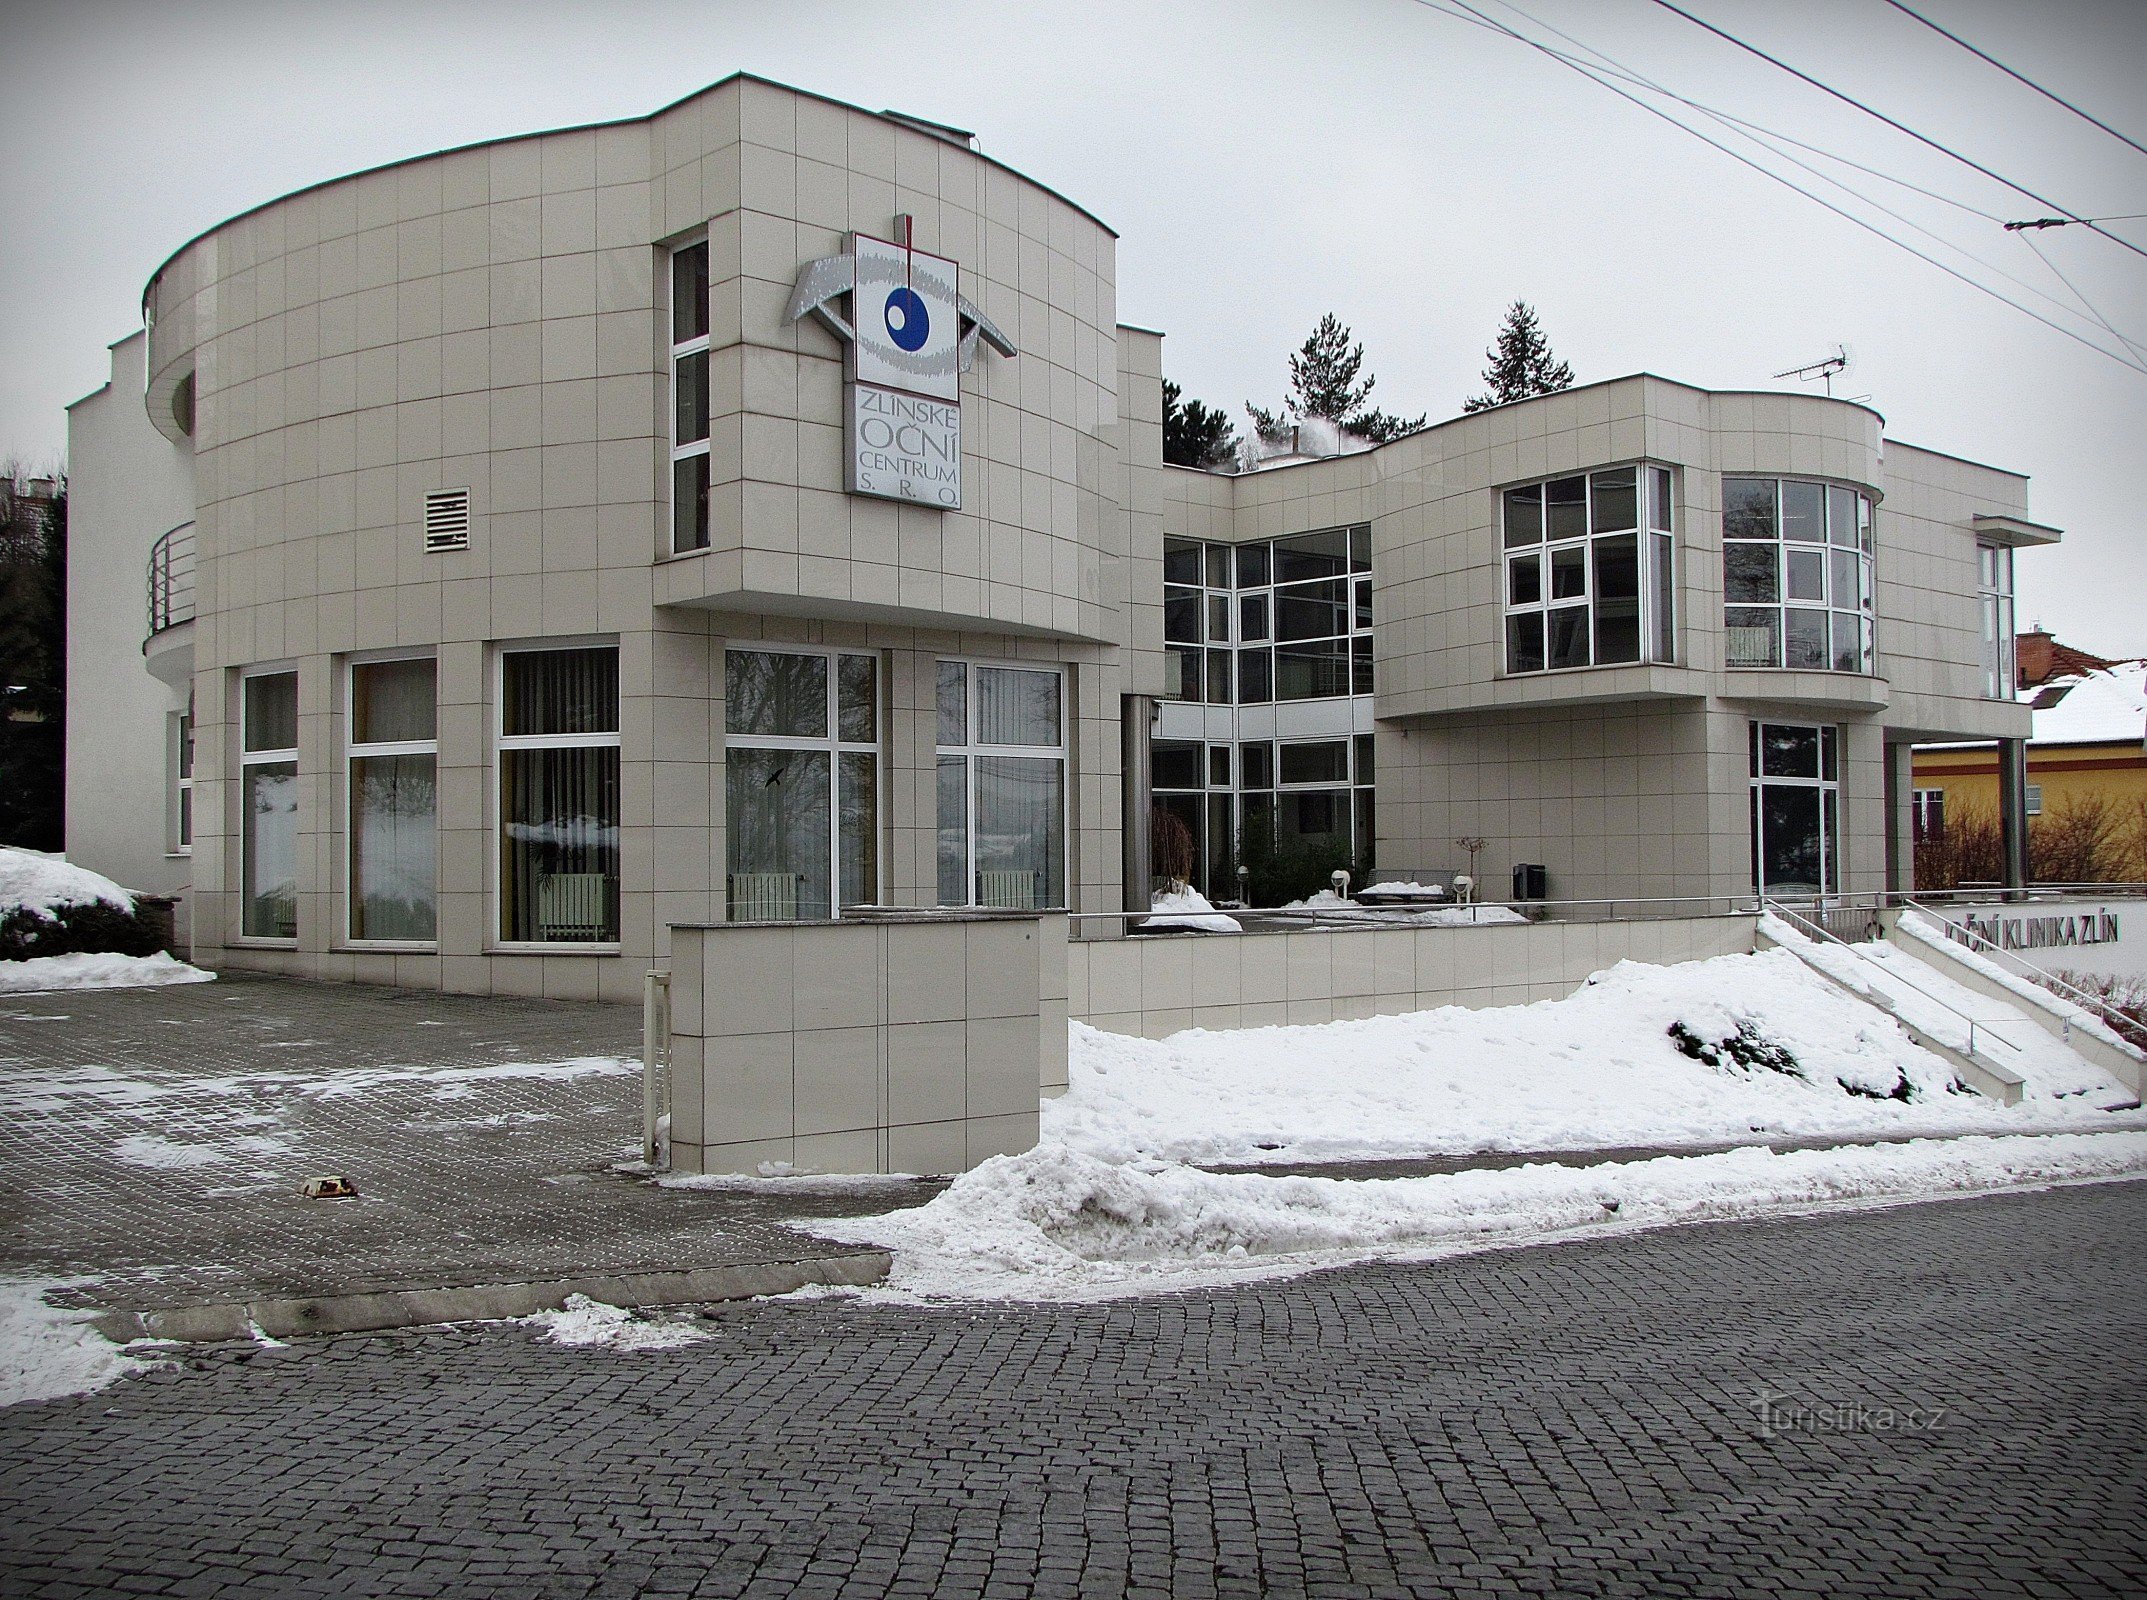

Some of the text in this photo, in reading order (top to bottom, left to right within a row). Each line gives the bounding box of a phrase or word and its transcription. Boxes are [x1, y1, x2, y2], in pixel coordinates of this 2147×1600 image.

[860, 389, 957, 430] ZLÍNSKÉ
[859, 417, 958, 463] OČNÍ
[859, 450, 957, 484] CENTRUM
